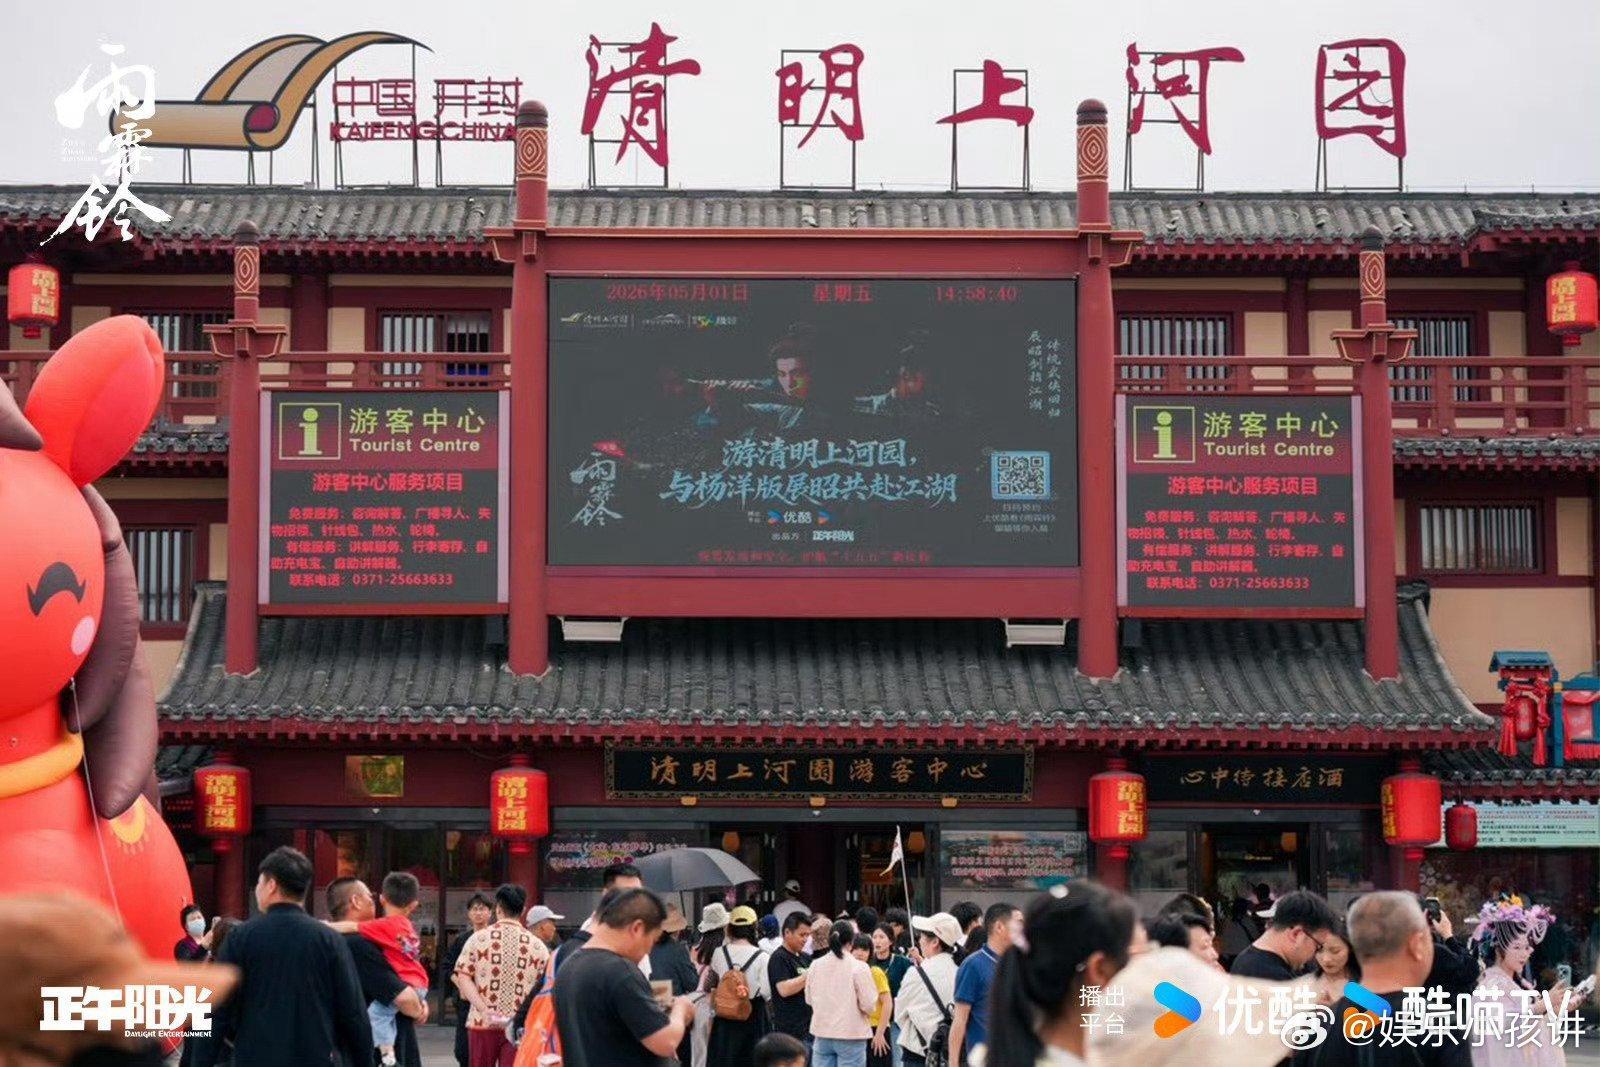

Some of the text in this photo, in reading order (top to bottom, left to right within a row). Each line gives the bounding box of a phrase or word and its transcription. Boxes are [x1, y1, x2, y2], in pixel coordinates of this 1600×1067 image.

[333, 76, 522, 117] 中国 开封
[581, 22, 1406, 168] 清明上河园
[606, 283, 1017, 304] 2026年05月01日 星期五 14:58:40
[349, 407, 486, 435] 游客中心
[1203, 411, 1340, 439] 游客中心
[349, 438, 481, 452] Tourist Centre
[1203, 442, 1335, 457] Tourist Centre
[312, 472, 464, 493] 游客中心服务项目
[659, 470, 958, 509] 与杨洋版展昭共赴江湖
[1167, 476, 1319, 496] 游客中心服务项目
[783, 510, 813, 525] 优酷
